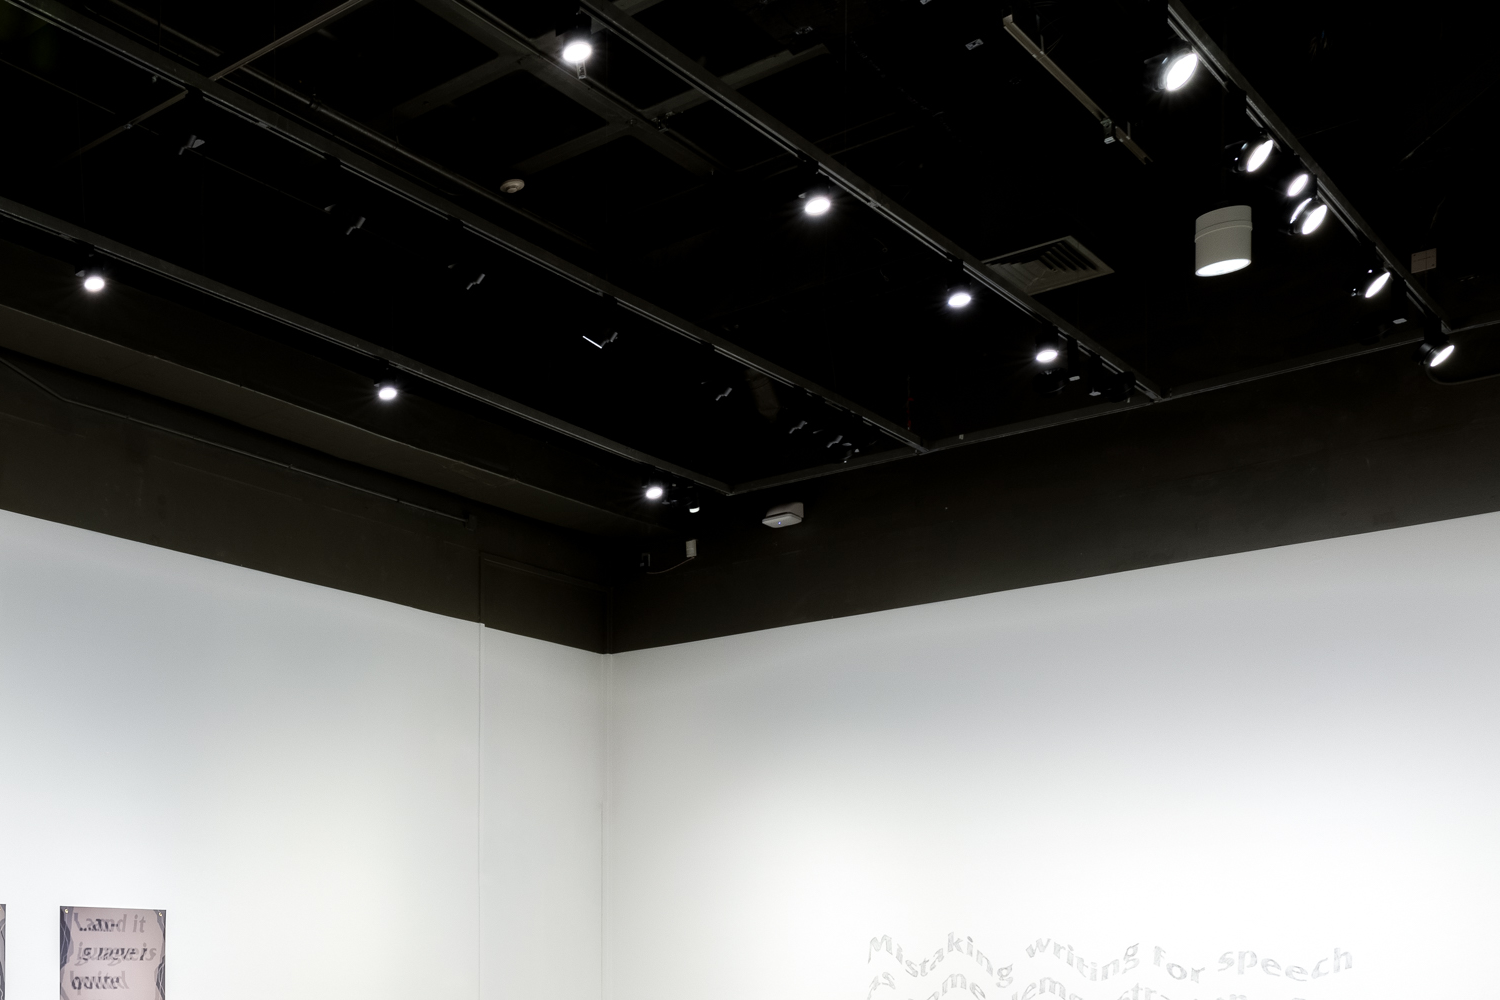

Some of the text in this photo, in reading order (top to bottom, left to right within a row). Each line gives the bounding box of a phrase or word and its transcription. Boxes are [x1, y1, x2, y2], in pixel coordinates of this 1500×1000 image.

[867, 931, 1353, 988] Mistaking writing for speech
